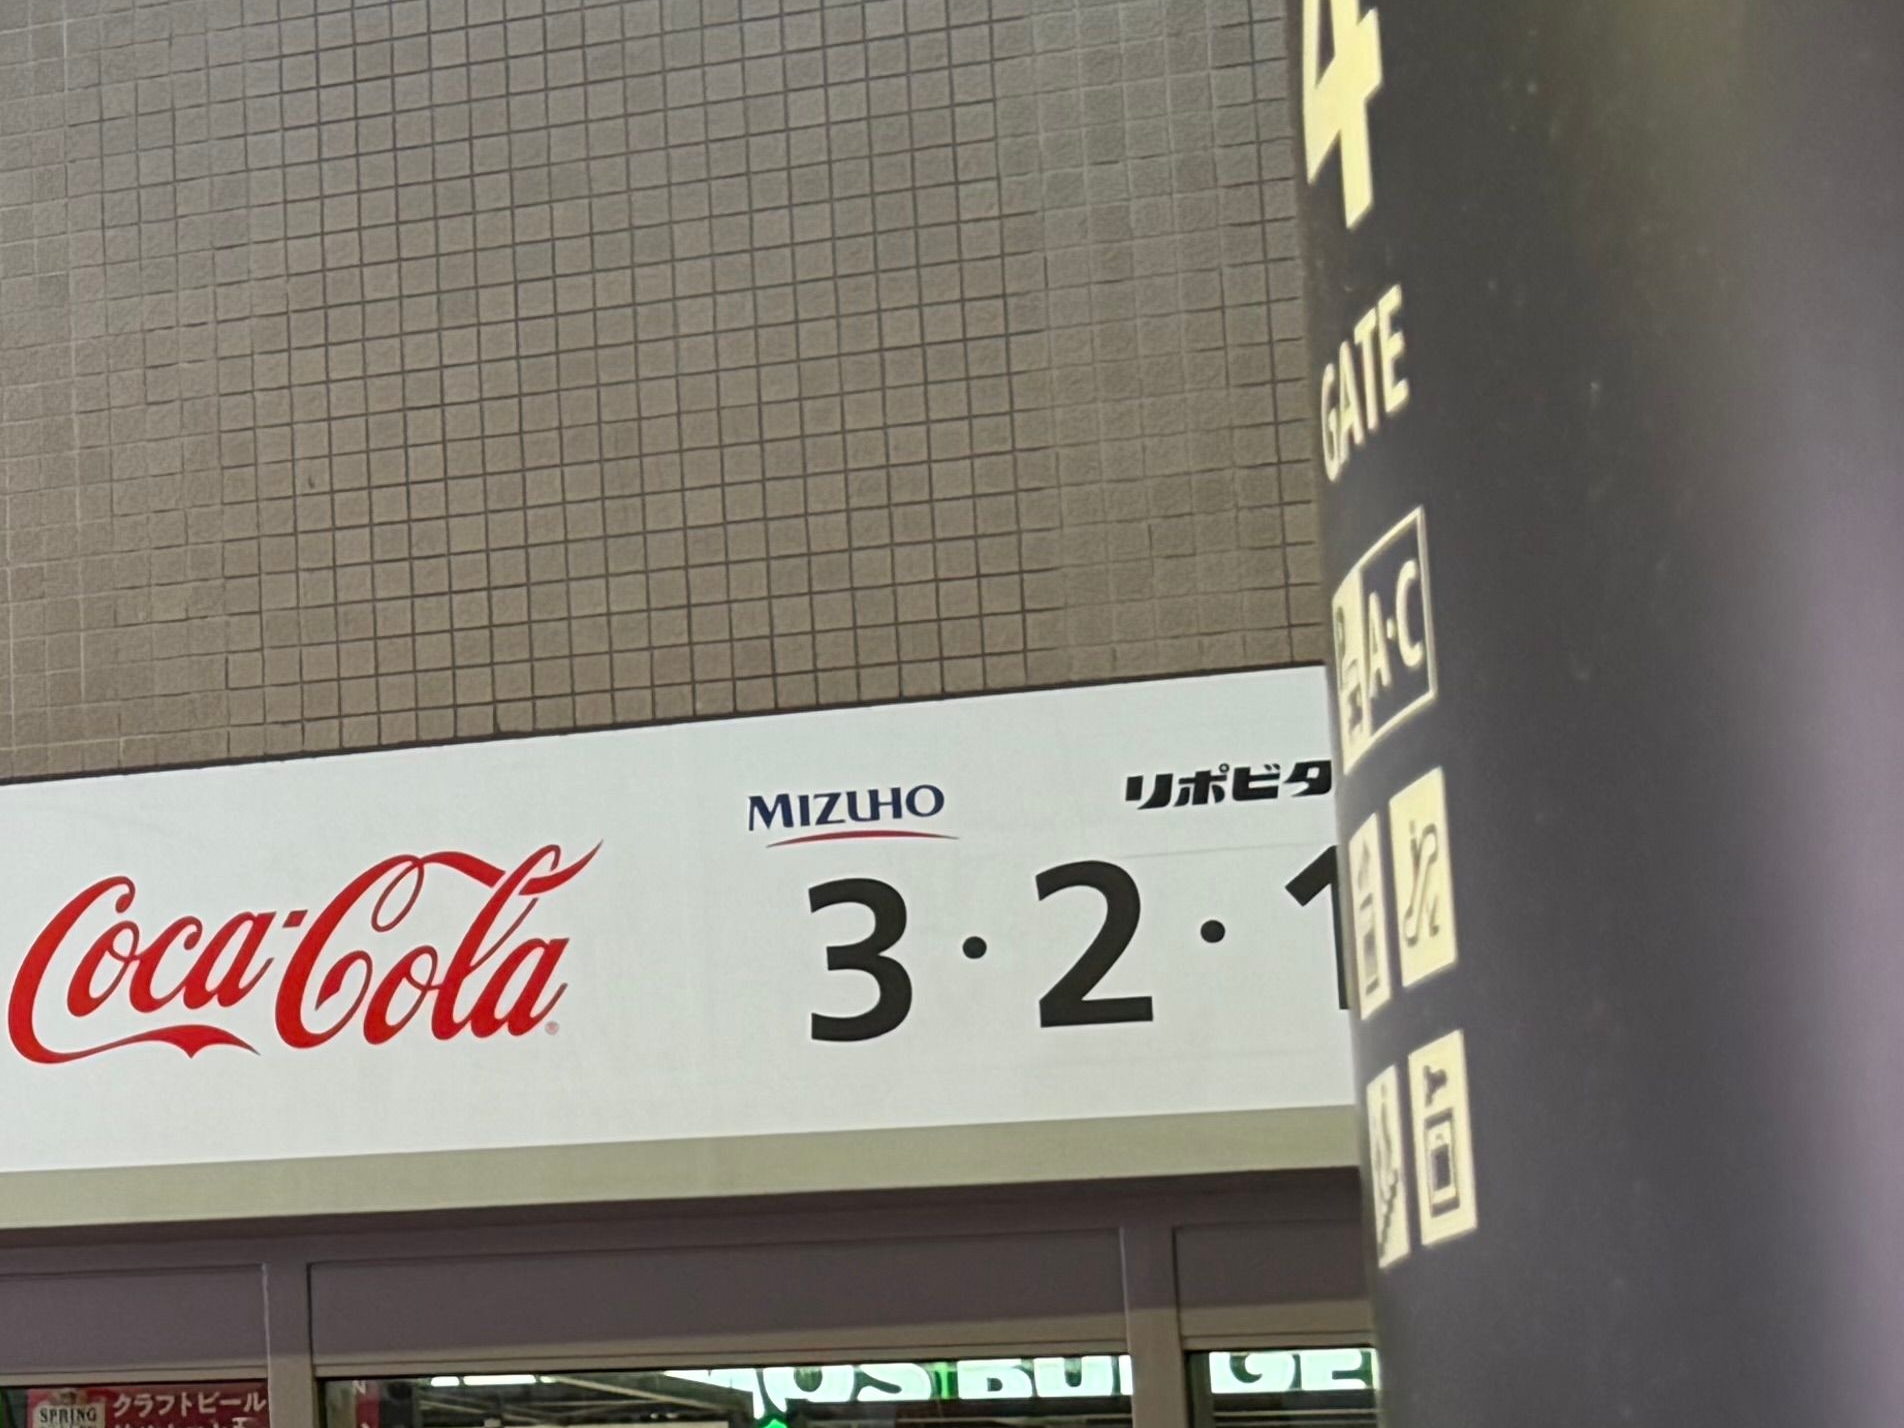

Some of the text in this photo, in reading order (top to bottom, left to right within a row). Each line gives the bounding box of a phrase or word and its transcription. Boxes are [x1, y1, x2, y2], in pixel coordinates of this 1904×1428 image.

[1321, 283, 1409, 483] GATE
[747, 784, 945, 830] MIZUHO
[1125, 761, 1333, 810] リポビタ
[7, 840, 603, 1064] Coca-Cola
[39, 1406, 97, 1422] SPRING
[113, 1391, 268, 1417] クラフトビール
